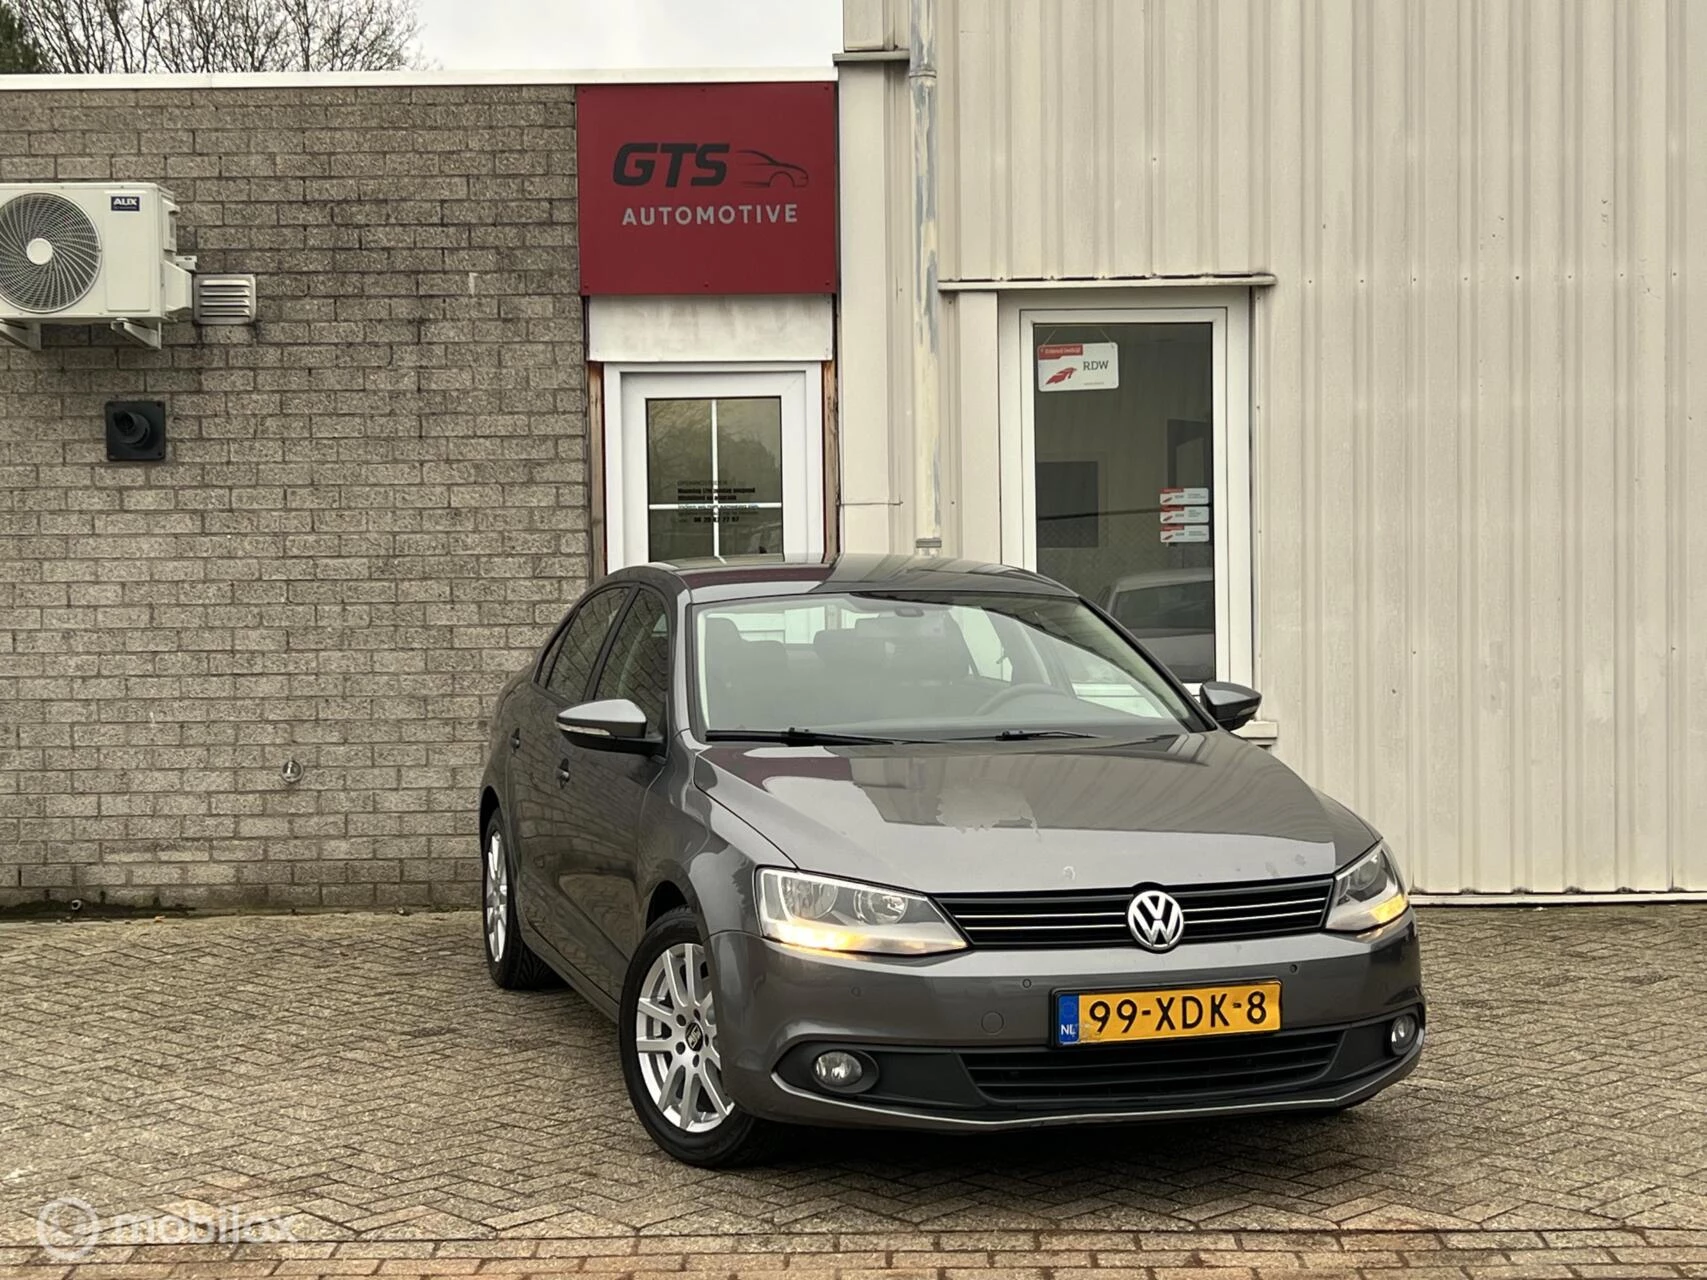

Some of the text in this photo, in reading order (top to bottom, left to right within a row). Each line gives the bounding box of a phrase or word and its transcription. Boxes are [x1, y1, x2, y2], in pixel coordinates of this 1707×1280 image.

[613, 142, 730, 188] GTS
[113, 198, 137, 206] AUX
[622, 204, 798, 226] AUTOMOTIVE
[1083, 360, 1109, 371] RDW
[1088, 991, 1267, 1034] 99-XDK-8
[1061, 1024, 1076, 1036] NL
